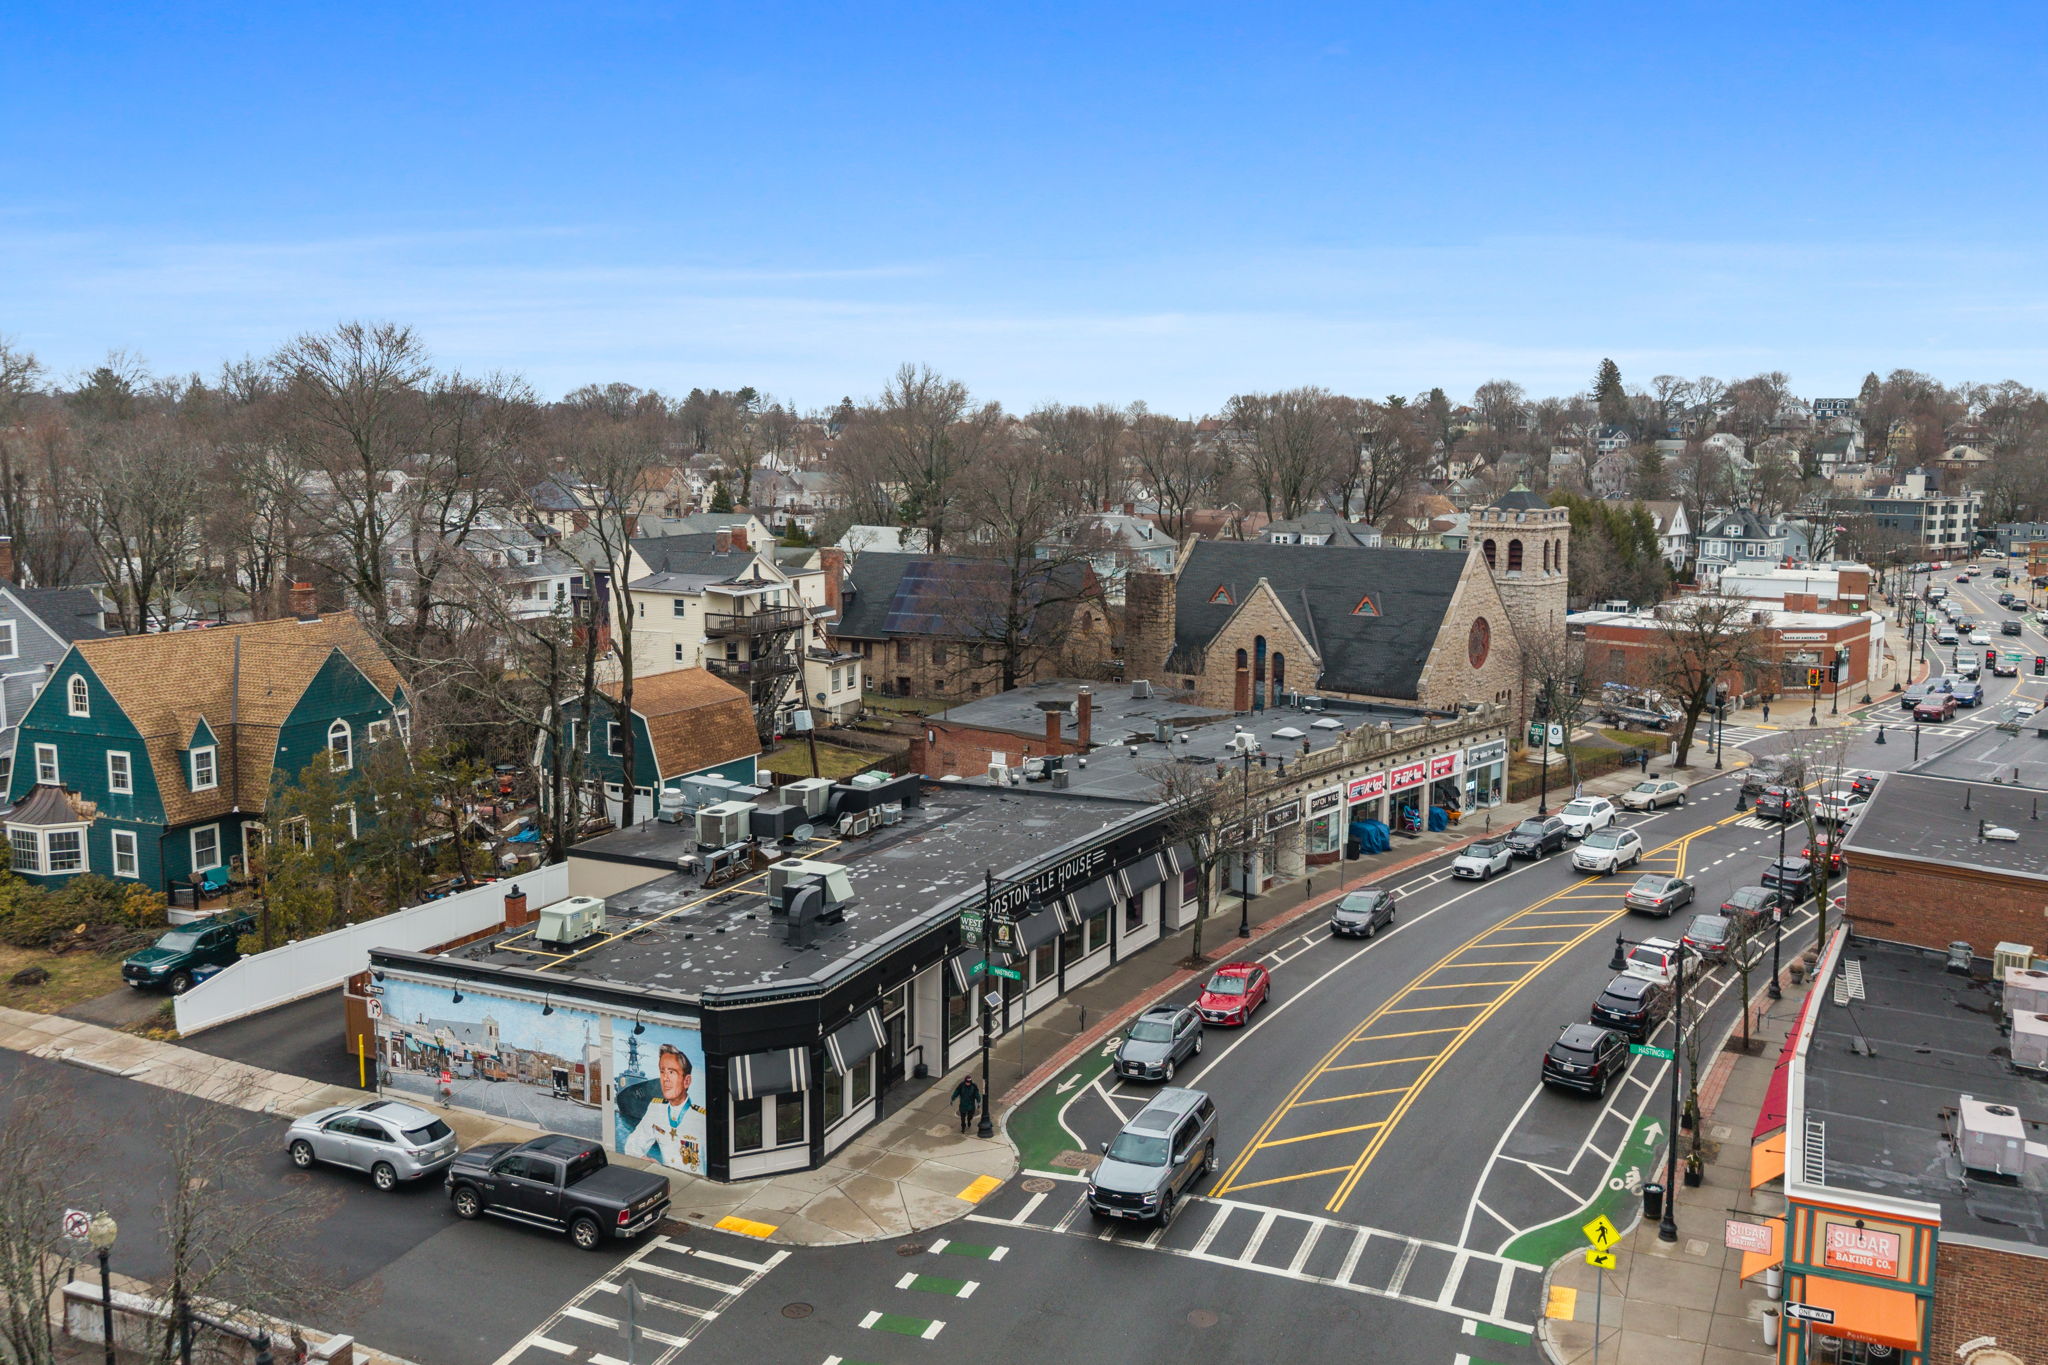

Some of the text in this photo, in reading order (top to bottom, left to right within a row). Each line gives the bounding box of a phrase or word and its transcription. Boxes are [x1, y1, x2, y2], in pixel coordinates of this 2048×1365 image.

[1058, 853, 1092, 883] HOUSE
[961, 917, 983, 928] WEST
[994, 967, 1014, 978] HASTINGS
[1638, 1046, 1665, 1058] HASTINGS
[1730, 1225, 1768, 1241] SUGAR
[1731, 1237, 1756, 1248] BAKING
[1834, 1230, 1890, 1257] SUGAR
[1835, 1251, 1892, 1271] BAKING CO.
[1798, 1307, 1829, 1320] ONE WAY
